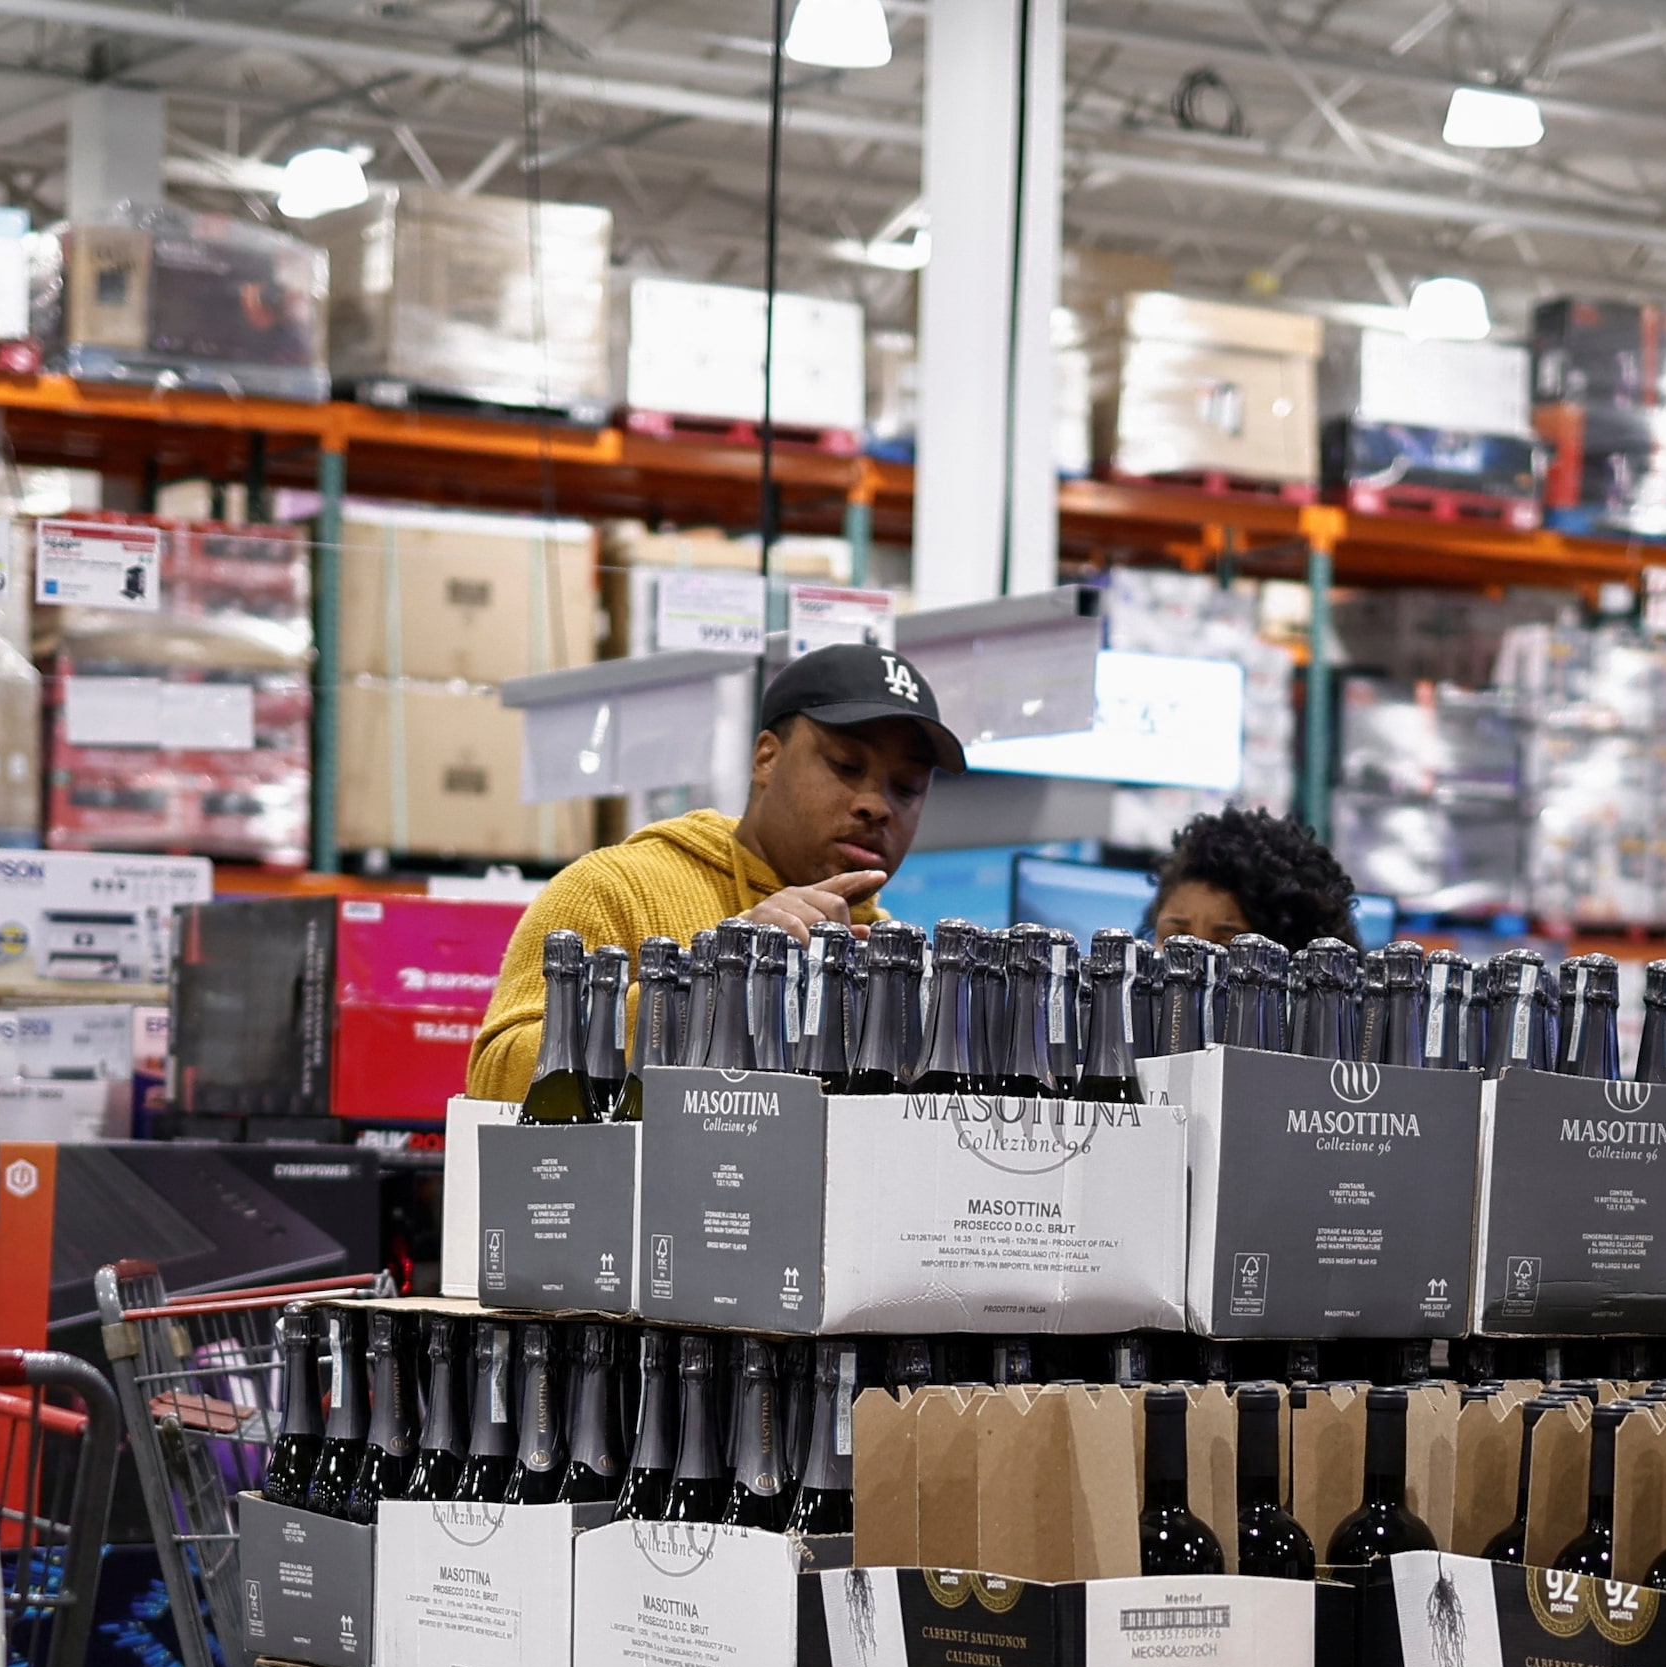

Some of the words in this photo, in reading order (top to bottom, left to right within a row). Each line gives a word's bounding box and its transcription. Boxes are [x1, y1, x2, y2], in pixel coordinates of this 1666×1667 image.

[881, 656, 918, 702] LA
[682, 1090, 780, 1116] MASOTTINA
[703, 1118, 745, 1133] Collezione
[746, 1119, 758, 1136] 96
[1286, 1110, 1421, 1137] MASOTTINA
[957, 1130, 1061, 1153] Collezione
[1067, 1140, 1091, 1155] 96
[1316, 1137, 1375, 1152] Collezione
[1378, 1141, 1391, 1156] 96
[1588, 1146, 1643, 1162] Collezione
[1646, 1150, 1658, 1164] 96
[968, 1199, 1062, 1218] MASOTTINA
[954, 1220, 1012, 1232] PROSECCO
[1014, 1222, 1045, 1234] D.O.C.
[1048, 1223, 1076, 1235] BRUT
[939, 1247, 980, 1256] MASOTTINA
[1052, 1238, 1085, 1248] PRODUCT
[1087, 1240, 1098, 1248] OF
[1099, 1240, 1119, 1248] ITALY
[921, 1260, 959, 1269] IMPORTED
[1033, 1264, 1049, 1272] NEW
[1091, 1265, 1100, 1273] NY
[439, 1565, 492, 1588] MASOTTINA
[1545, 1568, 1579, 1603] 92
[643, 1594, 699, 1619] MASOTTINA
[1165, 1593, 1202, 1604] Method
[1550, 1602, 1573, 1614] points
[1609, 1610, 1633, 1621] points
